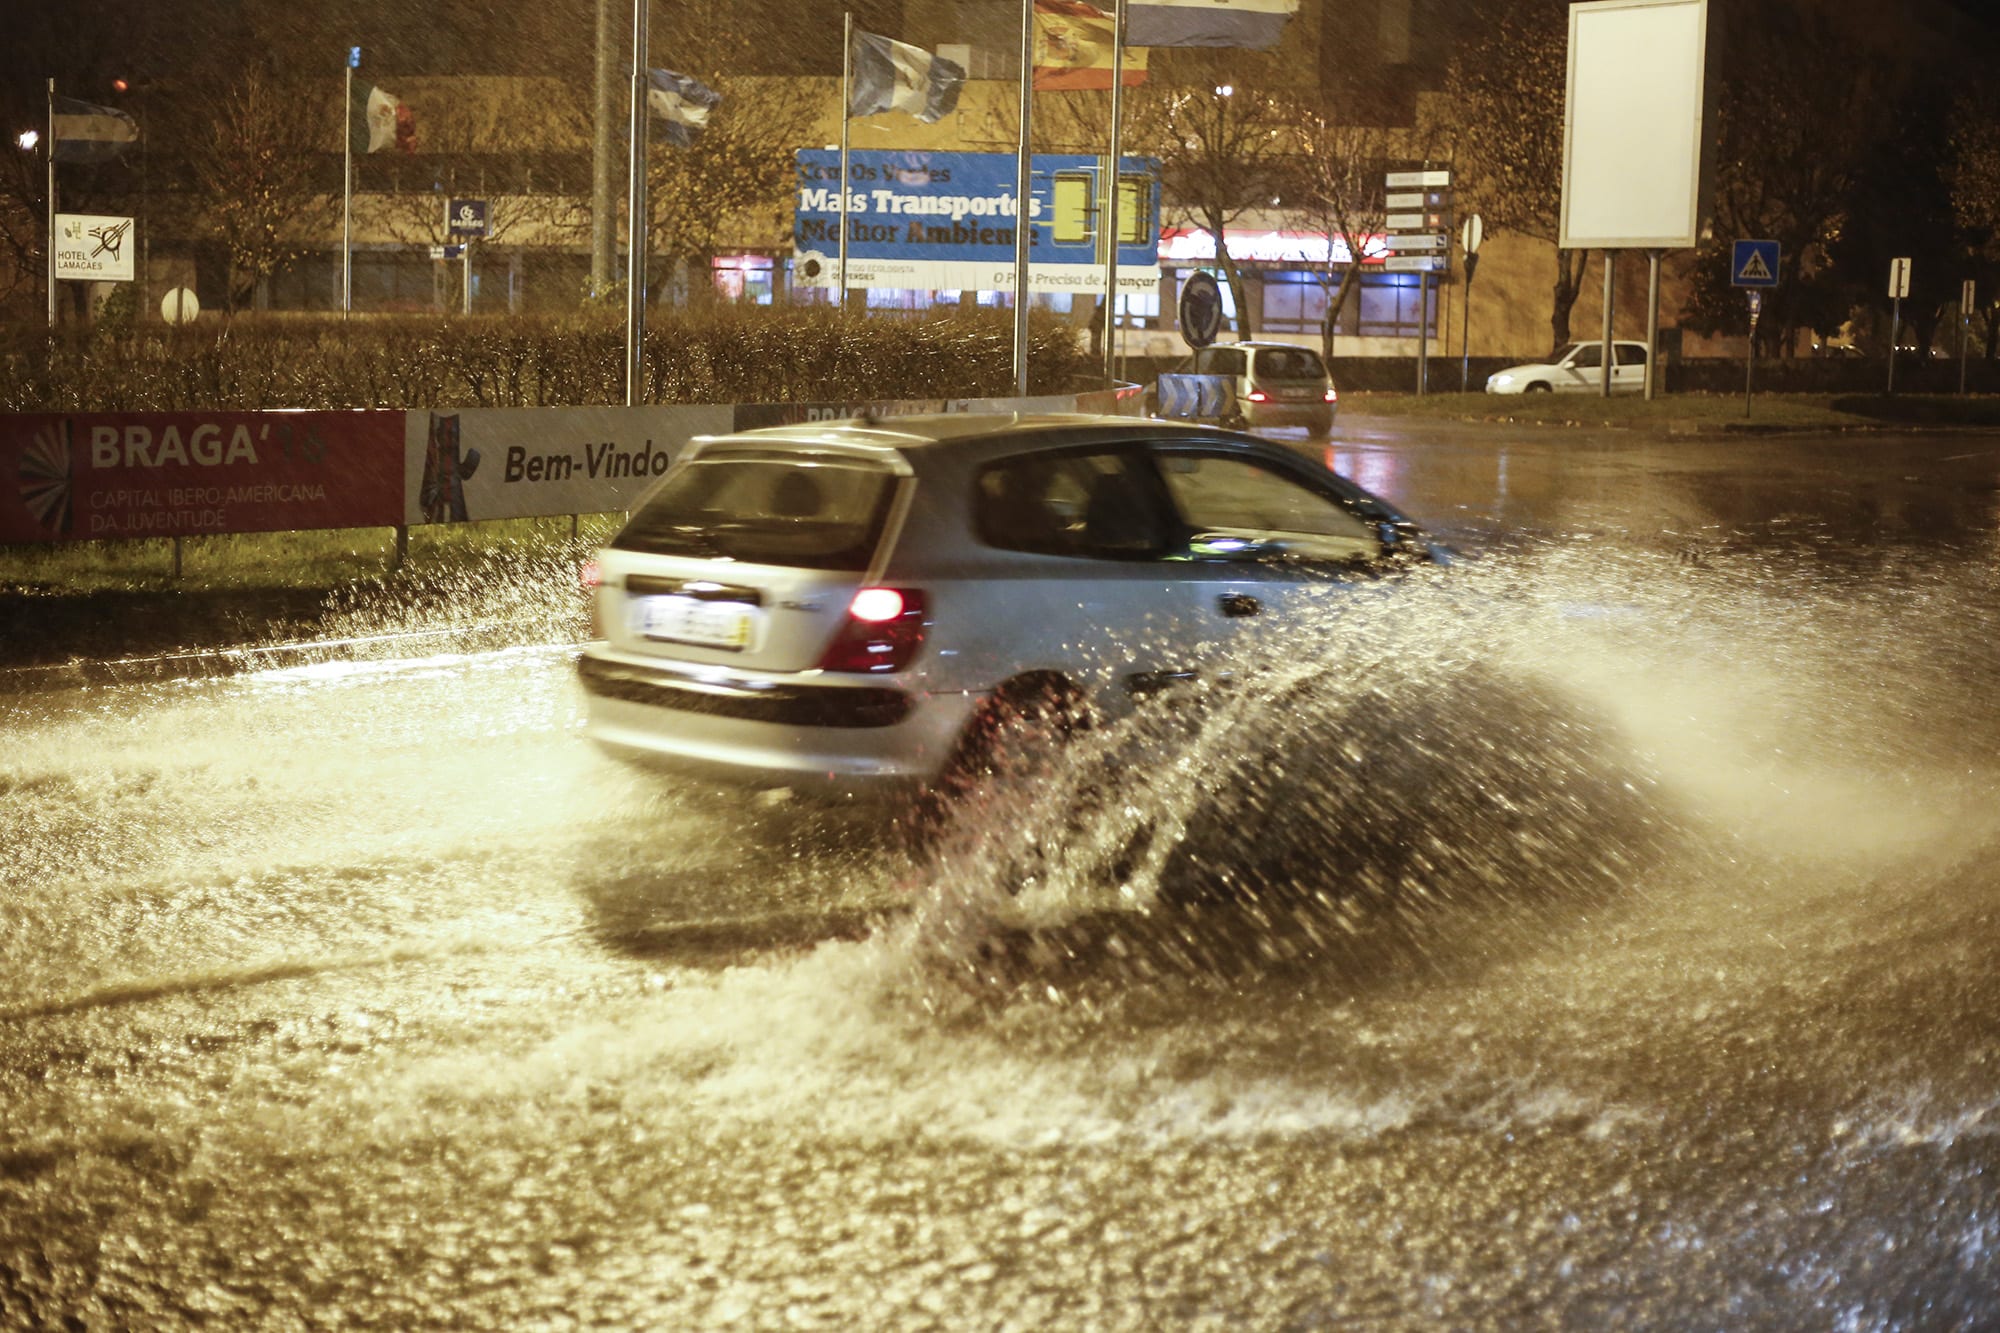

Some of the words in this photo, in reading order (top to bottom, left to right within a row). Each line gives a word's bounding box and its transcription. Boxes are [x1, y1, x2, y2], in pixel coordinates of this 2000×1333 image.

[852, 163, 877, 181] Os
[800, 187, 867, 213] Mais
[906, 219, 1039, 246] Ambiene
[58, 250, 87, 260] HOTEL
[993, 272, 1003, 284] O
[1035, 273, 1082, 286] Precisa
[1087, 272, 1100, 285] de
[1104, 274, 1157, 289] ançar
[504, 440, 669, 483] Bem-Vindo
[90, 489, 162, 510] CAPITAL
[168, 484, 326, 507] IBERO-AMERICANA
[90, 513, 118, 532] DA
[123, 509, 226, 531] JUVENTUDE
